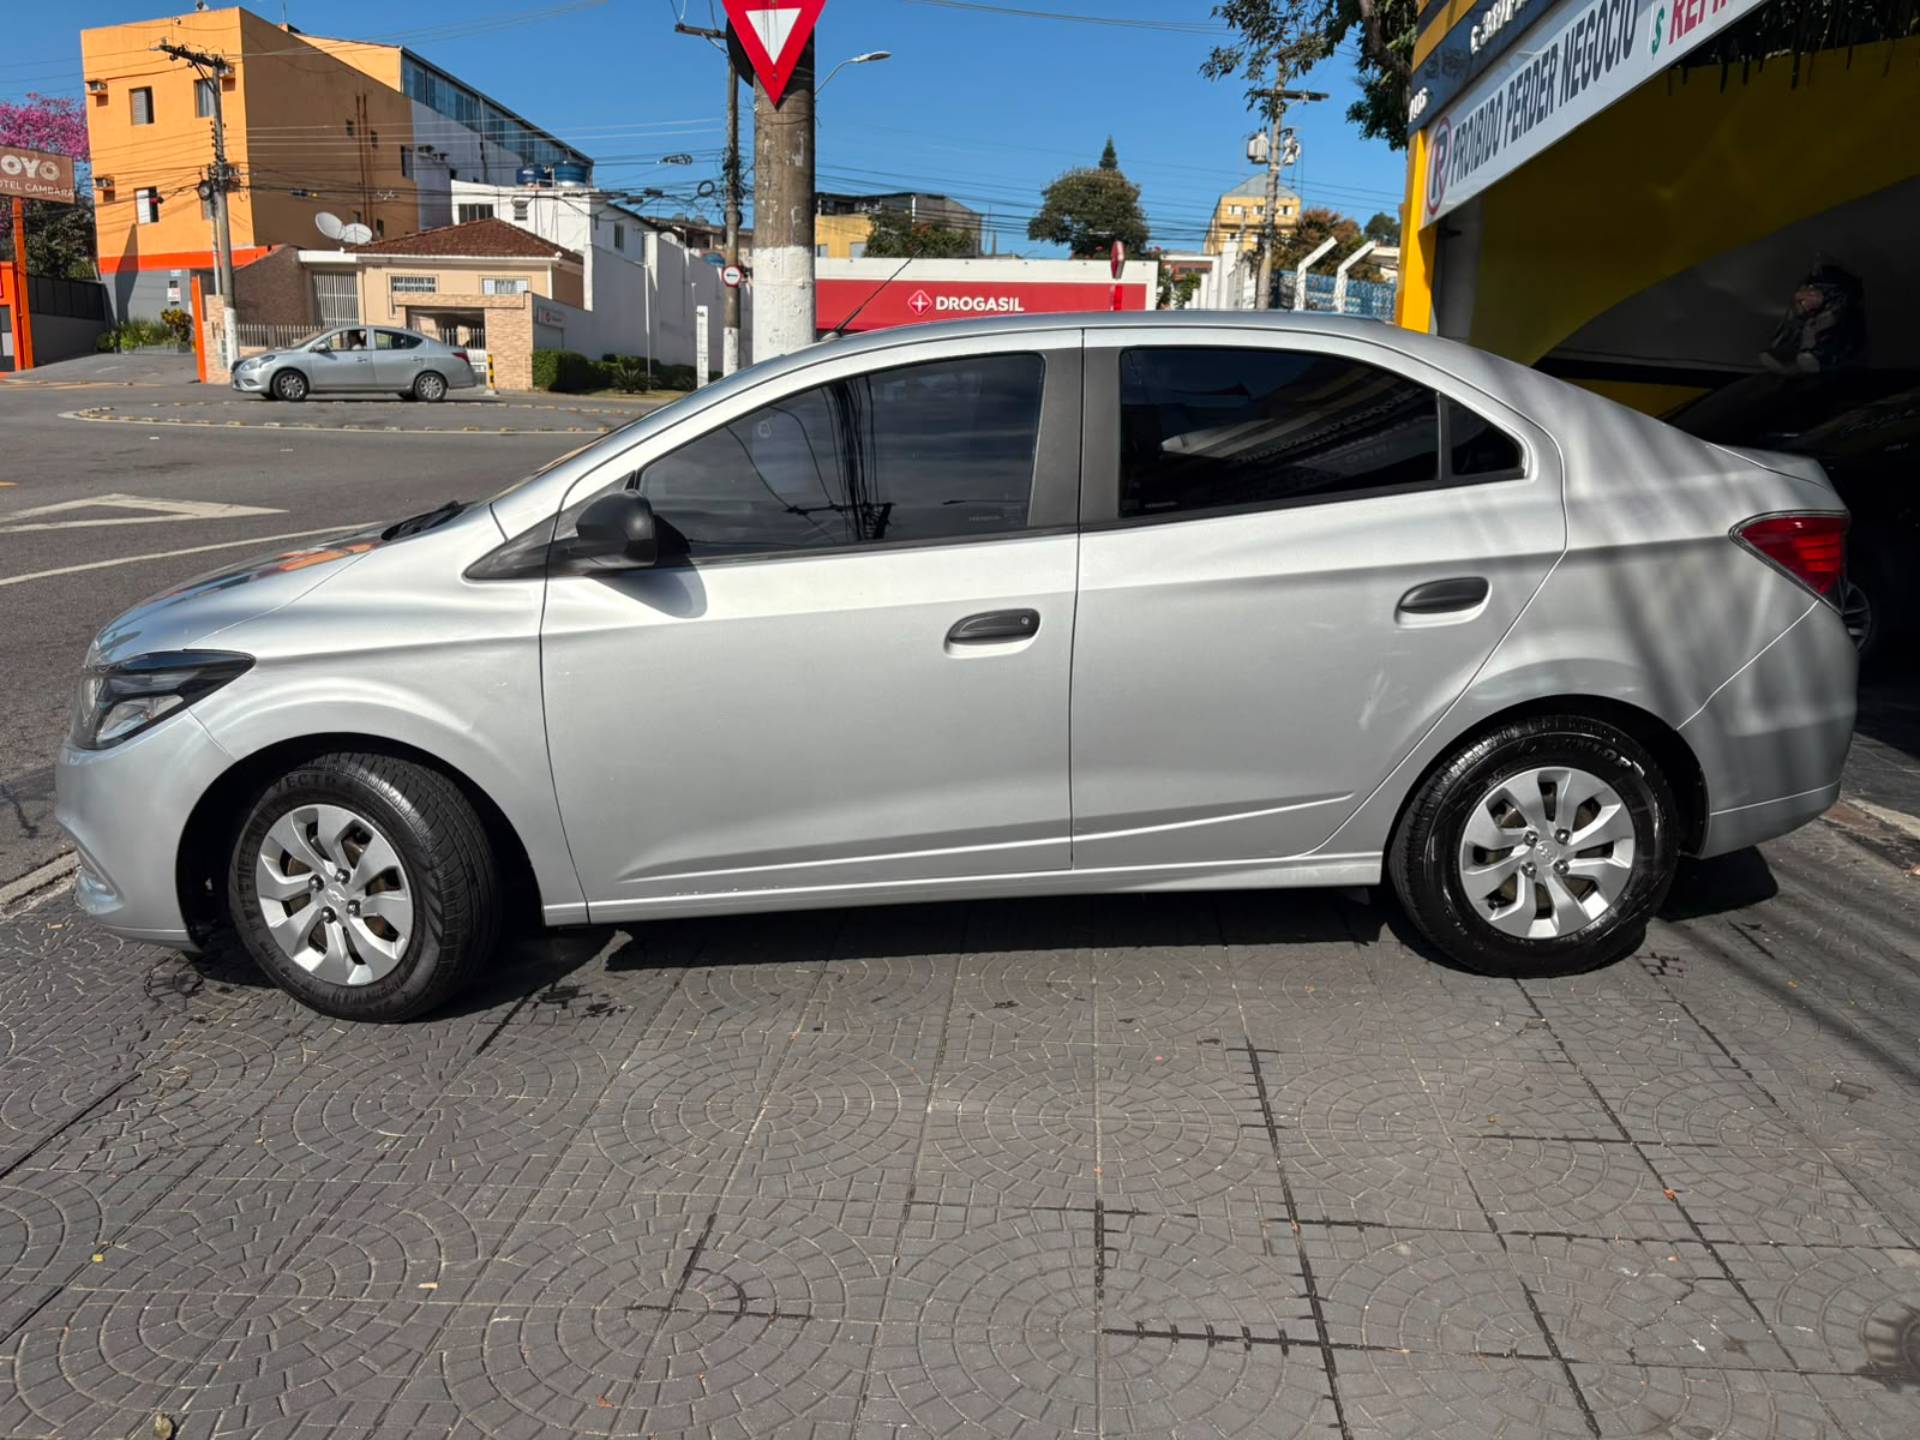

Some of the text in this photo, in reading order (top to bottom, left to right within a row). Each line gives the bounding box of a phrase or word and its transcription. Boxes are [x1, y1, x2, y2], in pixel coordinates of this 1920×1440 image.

[1450, 90, 1503, 187] PROIBIDO
[1504, 43, 1559, 149] PERDER
[1, 154, 60, 181] OYO
[935, 296, 1025, 312] DROGASIL
